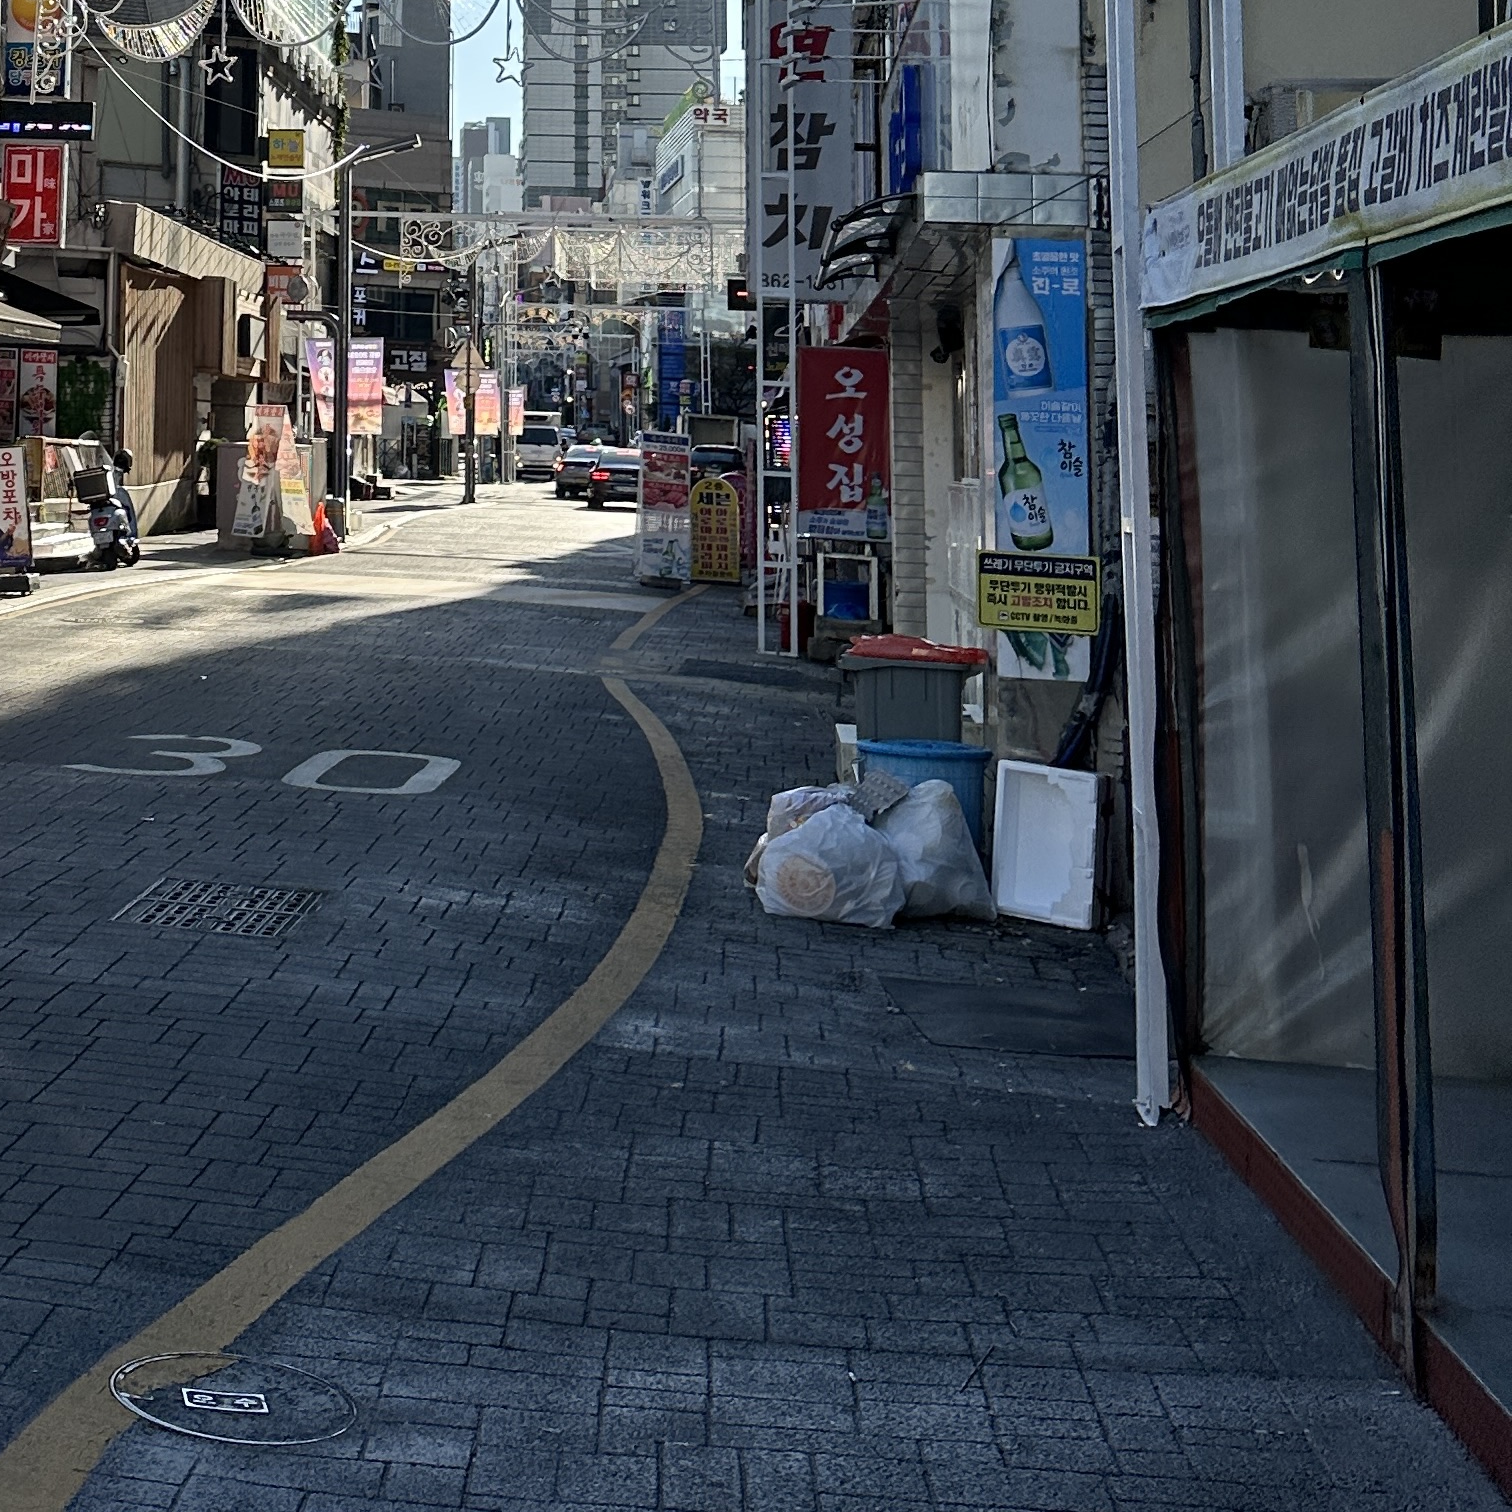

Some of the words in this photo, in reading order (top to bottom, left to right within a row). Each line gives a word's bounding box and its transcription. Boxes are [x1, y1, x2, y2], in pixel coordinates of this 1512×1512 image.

[11, 154, 47, 237] 미가
[825, 365, 868, 503] 오성집
[1057, 439, 1084, 477] 참이슬
[983, 557, 1013, 571] 쓰레기
[1014, 560, 1053, 574] 무단투기
[1054, 562, 1094, 576] 금지구역
[987, 592, 1008, 606] 즉시
[989, 579, 1031, 594] 무단투기
[1010, 612, 1030, 622] CCTV
[61, 733, 462, 795] 30
